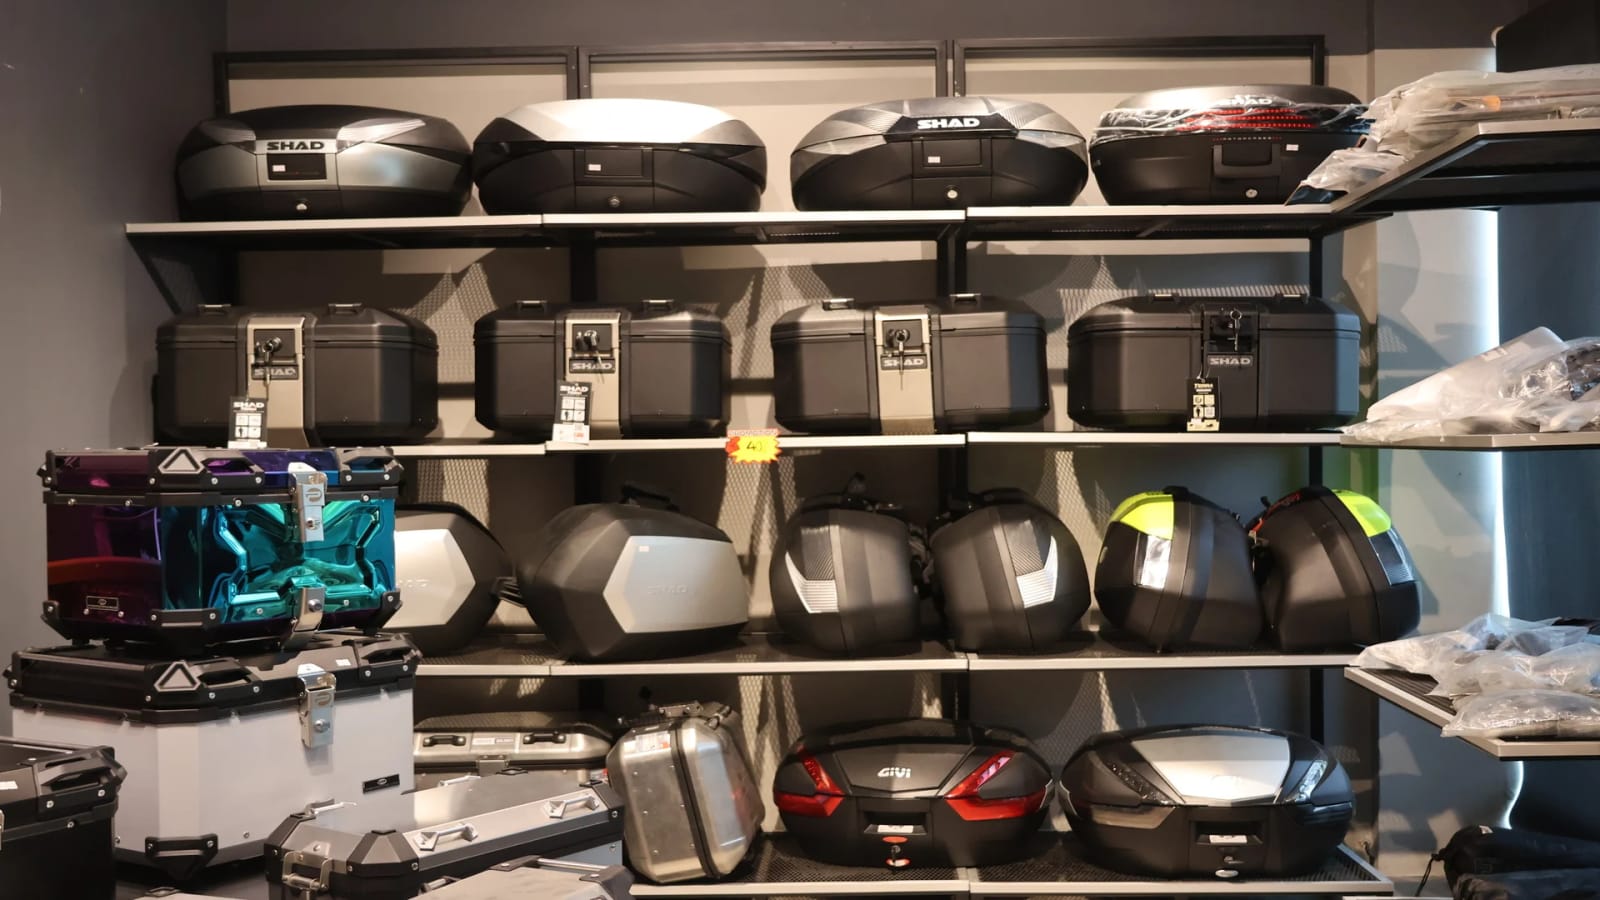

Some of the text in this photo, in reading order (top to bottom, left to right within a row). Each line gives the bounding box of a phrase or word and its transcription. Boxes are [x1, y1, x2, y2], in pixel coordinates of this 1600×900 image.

[1222, 98, 1273, 106] HAD
[917, 117, 981, 129] SHAD
[266, 141, 325, 151] SHAD
[1209, 357, 1251, 366] SHAD
[232, 401, 265, 409] SHAD
